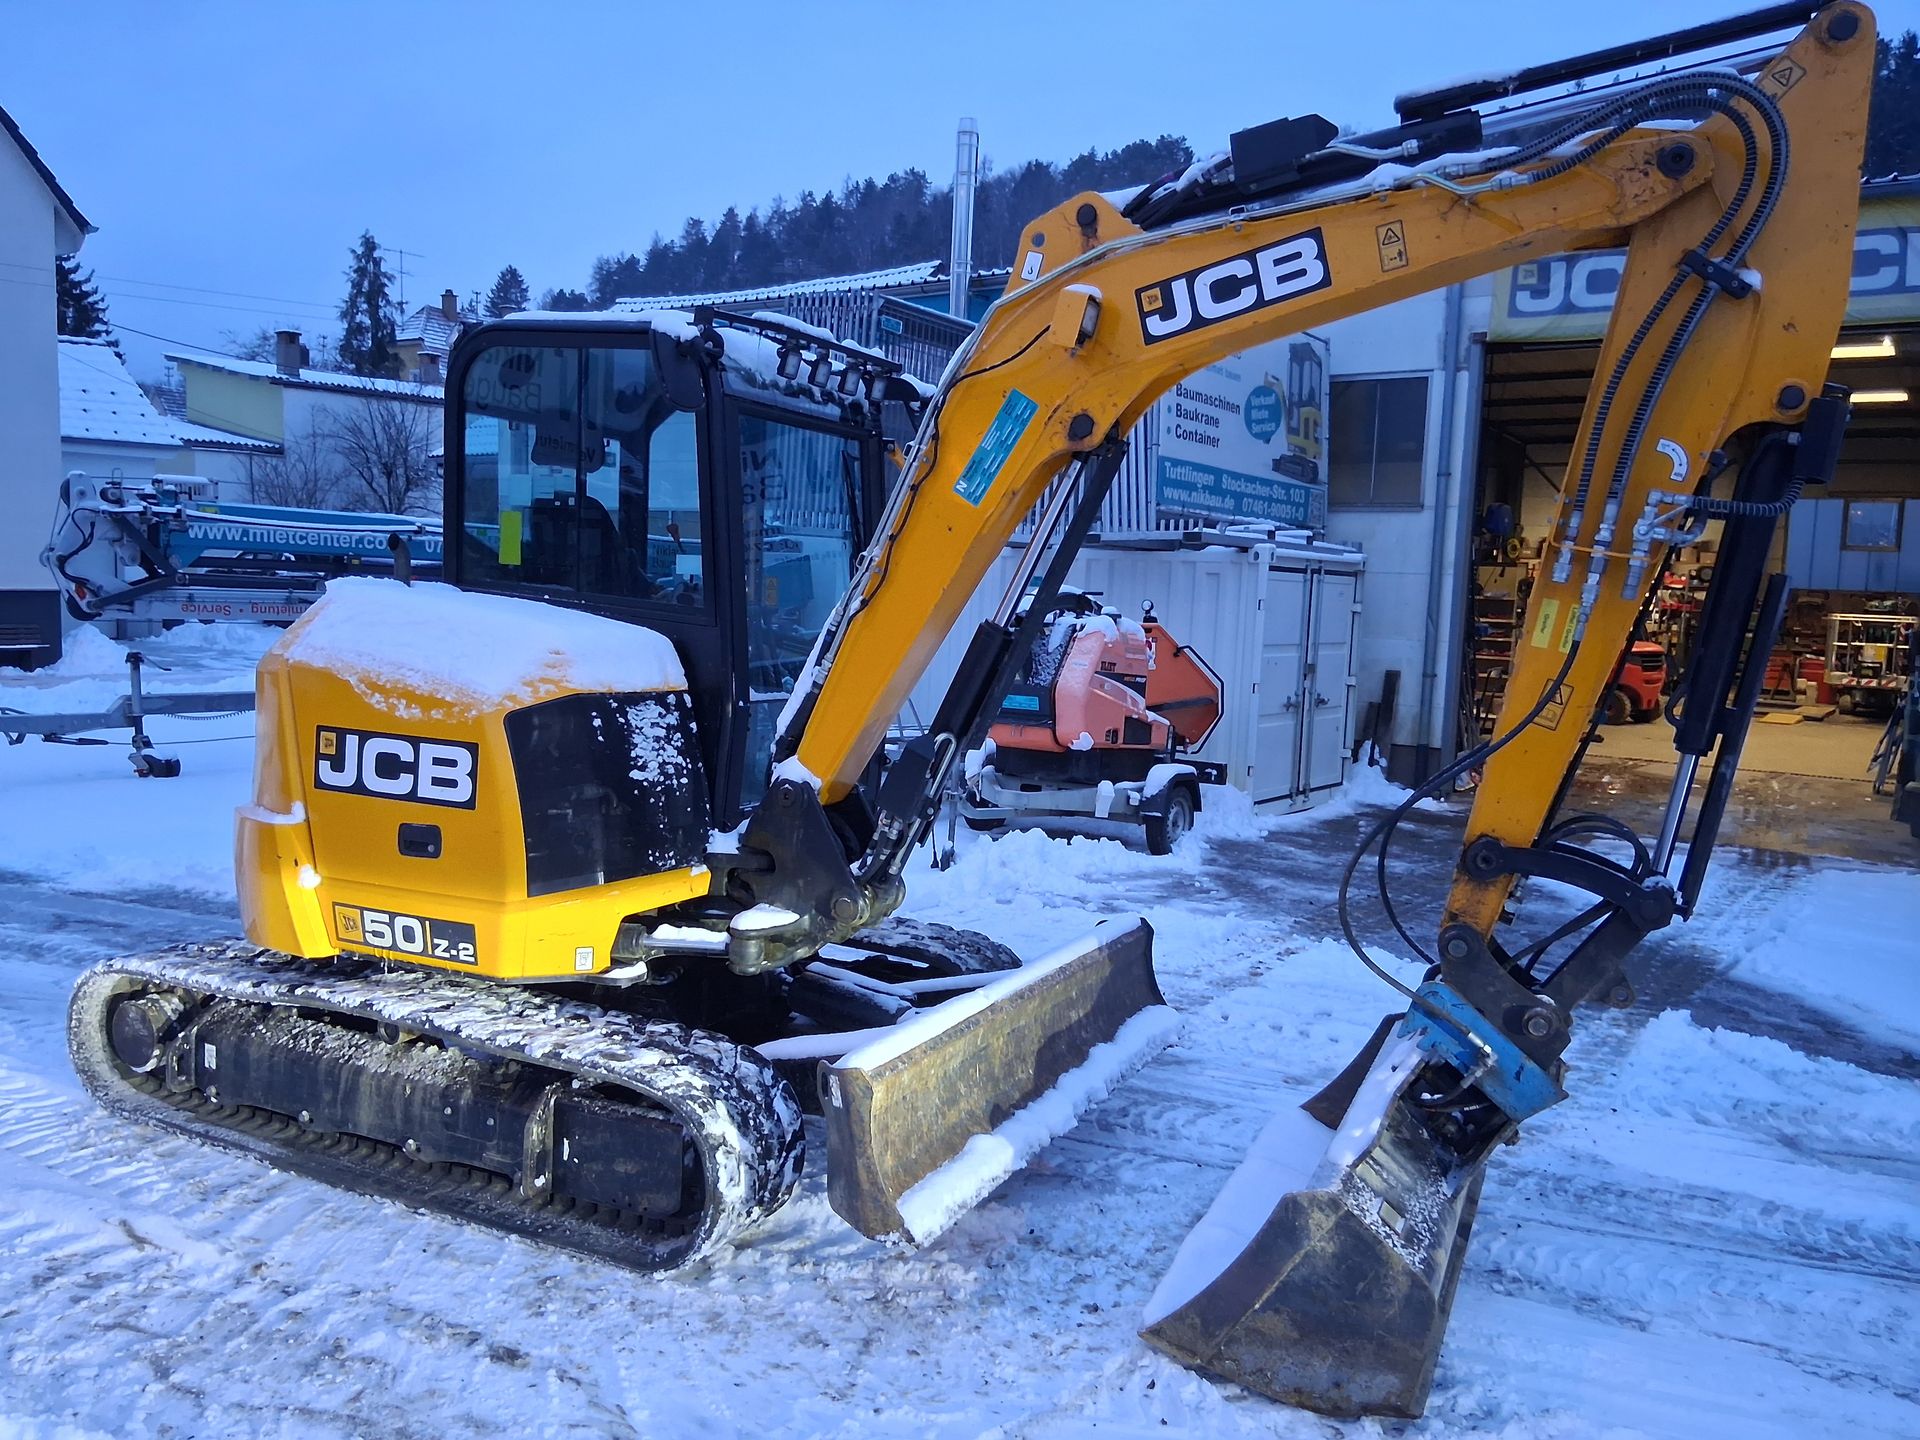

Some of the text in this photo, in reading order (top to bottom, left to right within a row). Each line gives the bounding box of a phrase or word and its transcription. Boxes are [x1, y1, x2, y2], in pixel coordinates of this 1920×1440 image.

[1145, 236, 1324, 337] JCB
[1515, 255, 1627, 313] JC
[1175, 382, 1241, 416] Baumaschinen
[1250, 394, 1276, 407] Verkauf
[1175, 402, 1220, 429] Baukrane
[1250, 408, 1270, 421] Miete
[1251, 421, 1276, 434] Service
[1174, 424, 1221, 449] Container
[1164, 462, 1305, 504] Tuttlingen Stockacher-Str. 103
[1163, 486, 1235, 510] www.nikbau.de
[187, 522, 389, 551] www.mietcenter.co
[181, 604, 231, 617] Service
[318, 734, 473, 803] JCB
[363, 909, 424, 954] 50
